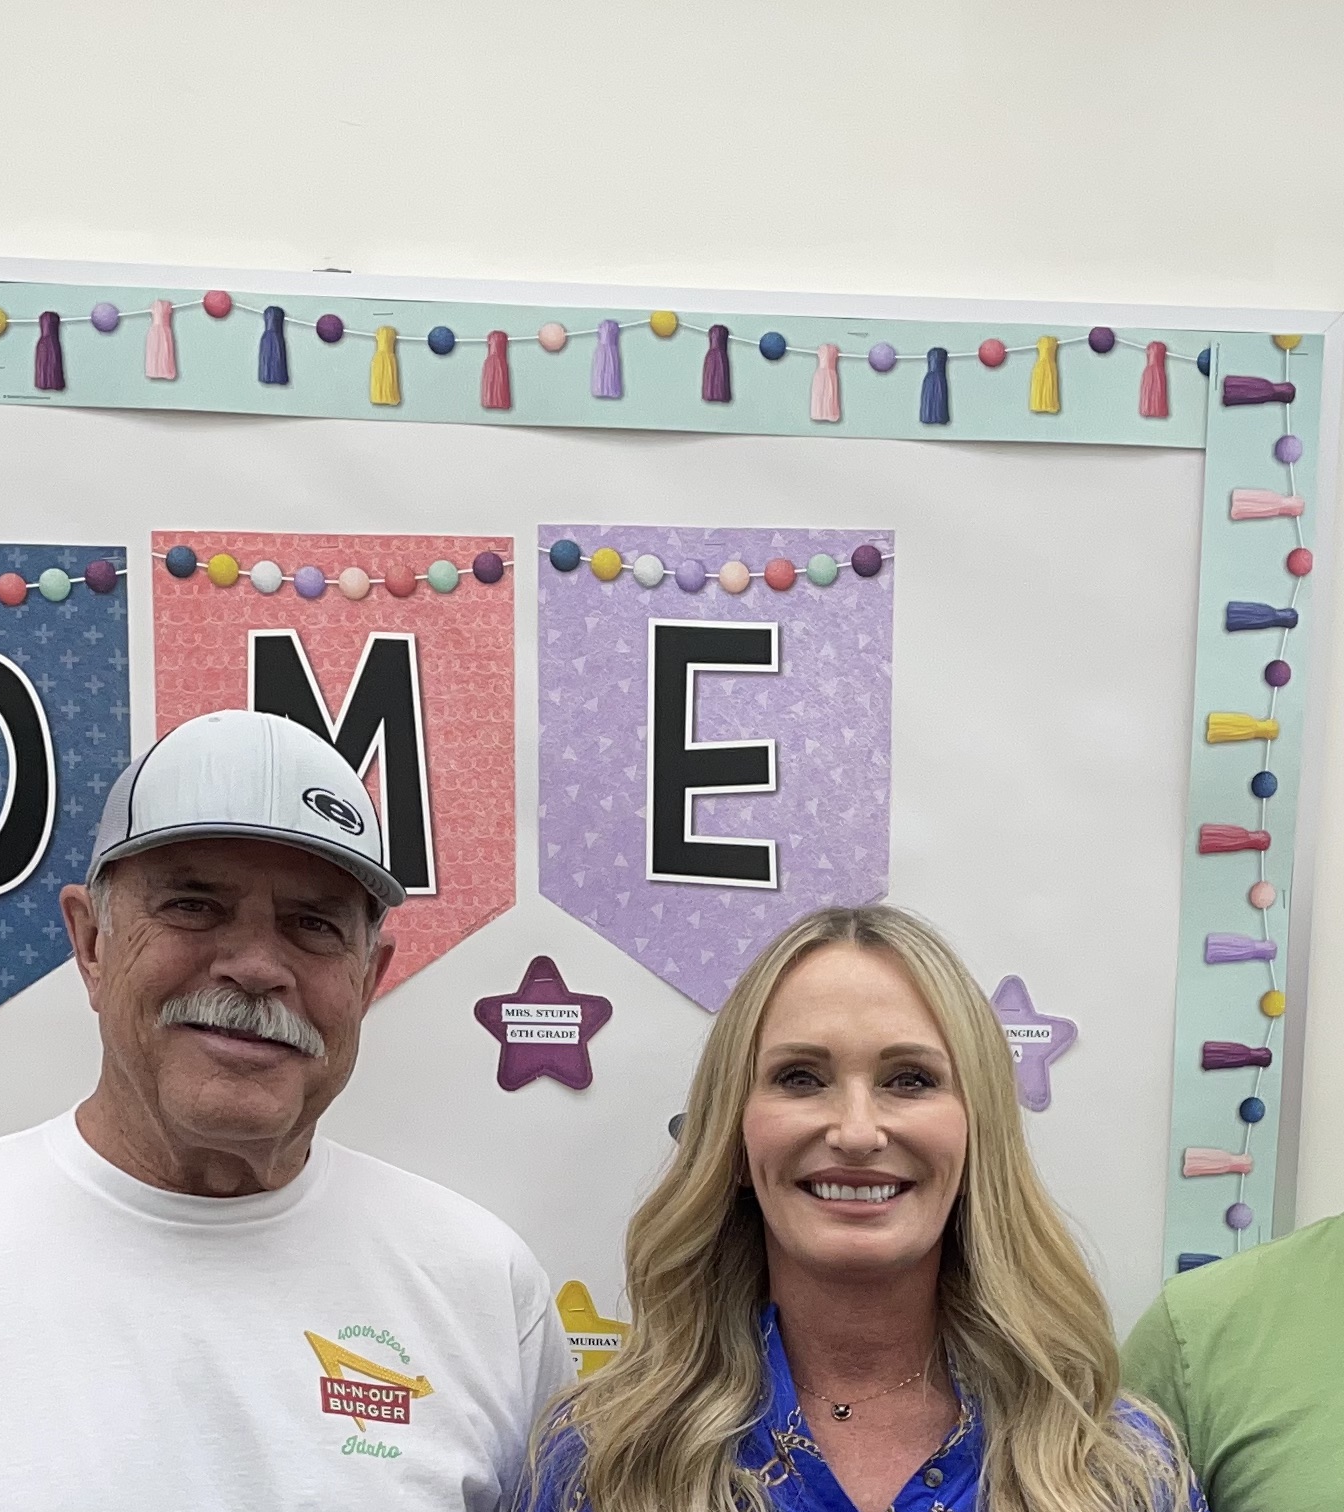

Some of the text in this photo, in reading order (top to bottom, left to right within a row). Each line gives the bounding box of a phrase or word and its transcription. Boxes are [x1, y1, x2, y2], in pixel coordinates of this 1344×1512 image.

[505, 1008, 579, 1019] MRS. STUPIN
[510, 1028, 577, 1039] 6TH GRADE
[338, 1325, 410, 1365] 400th Store
[326, 1381, 407, 1404] IN-N-OUT
[330, 1398, 405, 1420] BURGER
[341, 1435, 402, 1458] Idaho
